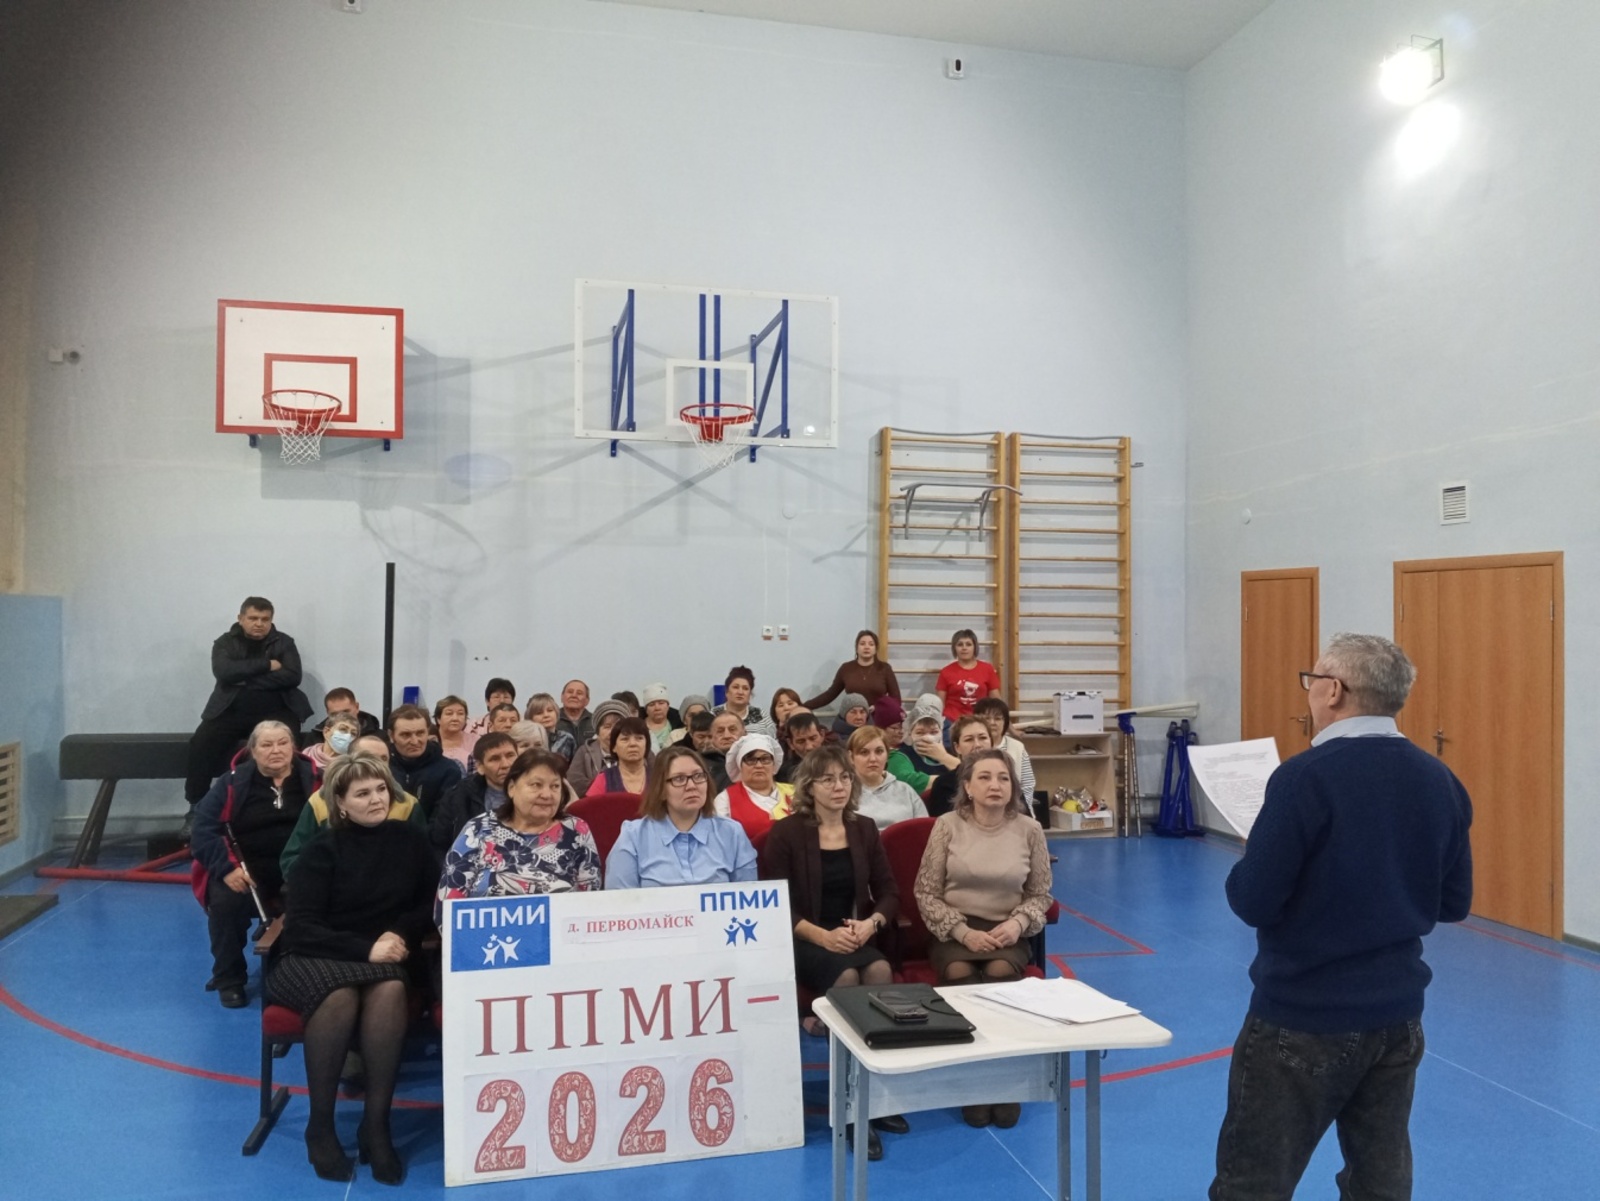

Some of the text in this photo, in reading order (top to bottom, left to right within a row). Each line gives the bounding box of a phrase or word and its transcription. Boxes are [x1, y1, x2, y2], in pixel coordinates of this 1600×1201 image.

[700, 889, 779, 912] ППМИ
[456, 904, 546, 930] ППМИ
[586, 914, 694, 933] ПЕРВОМАЙСК
[474, 1058, 735, 1173] 2026
